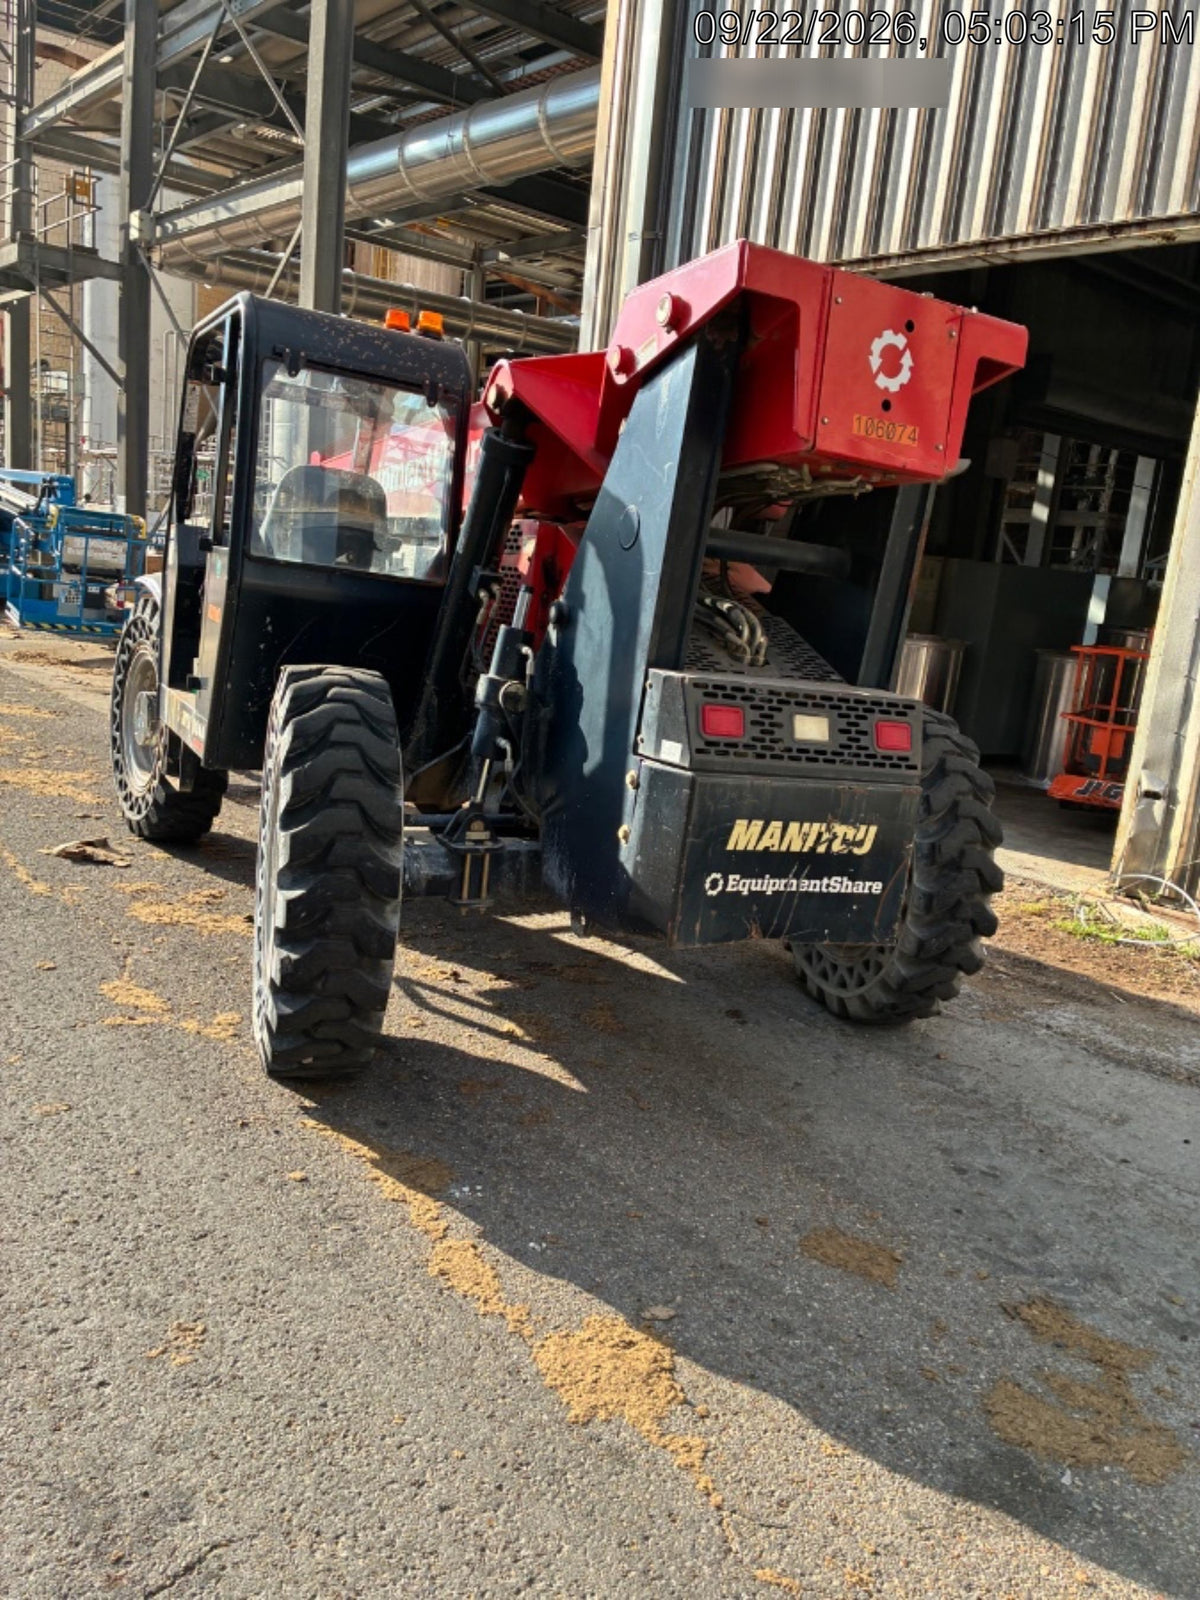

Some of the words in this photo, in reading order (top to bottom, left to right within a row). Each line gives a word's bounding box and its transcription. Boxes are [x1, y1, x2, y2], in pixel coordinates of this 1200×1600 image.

[854, 414, 918, 443] 106074
[726, 819, 878, 856] MANITOU
[725, 873, 883, 896] EquipmentShare
